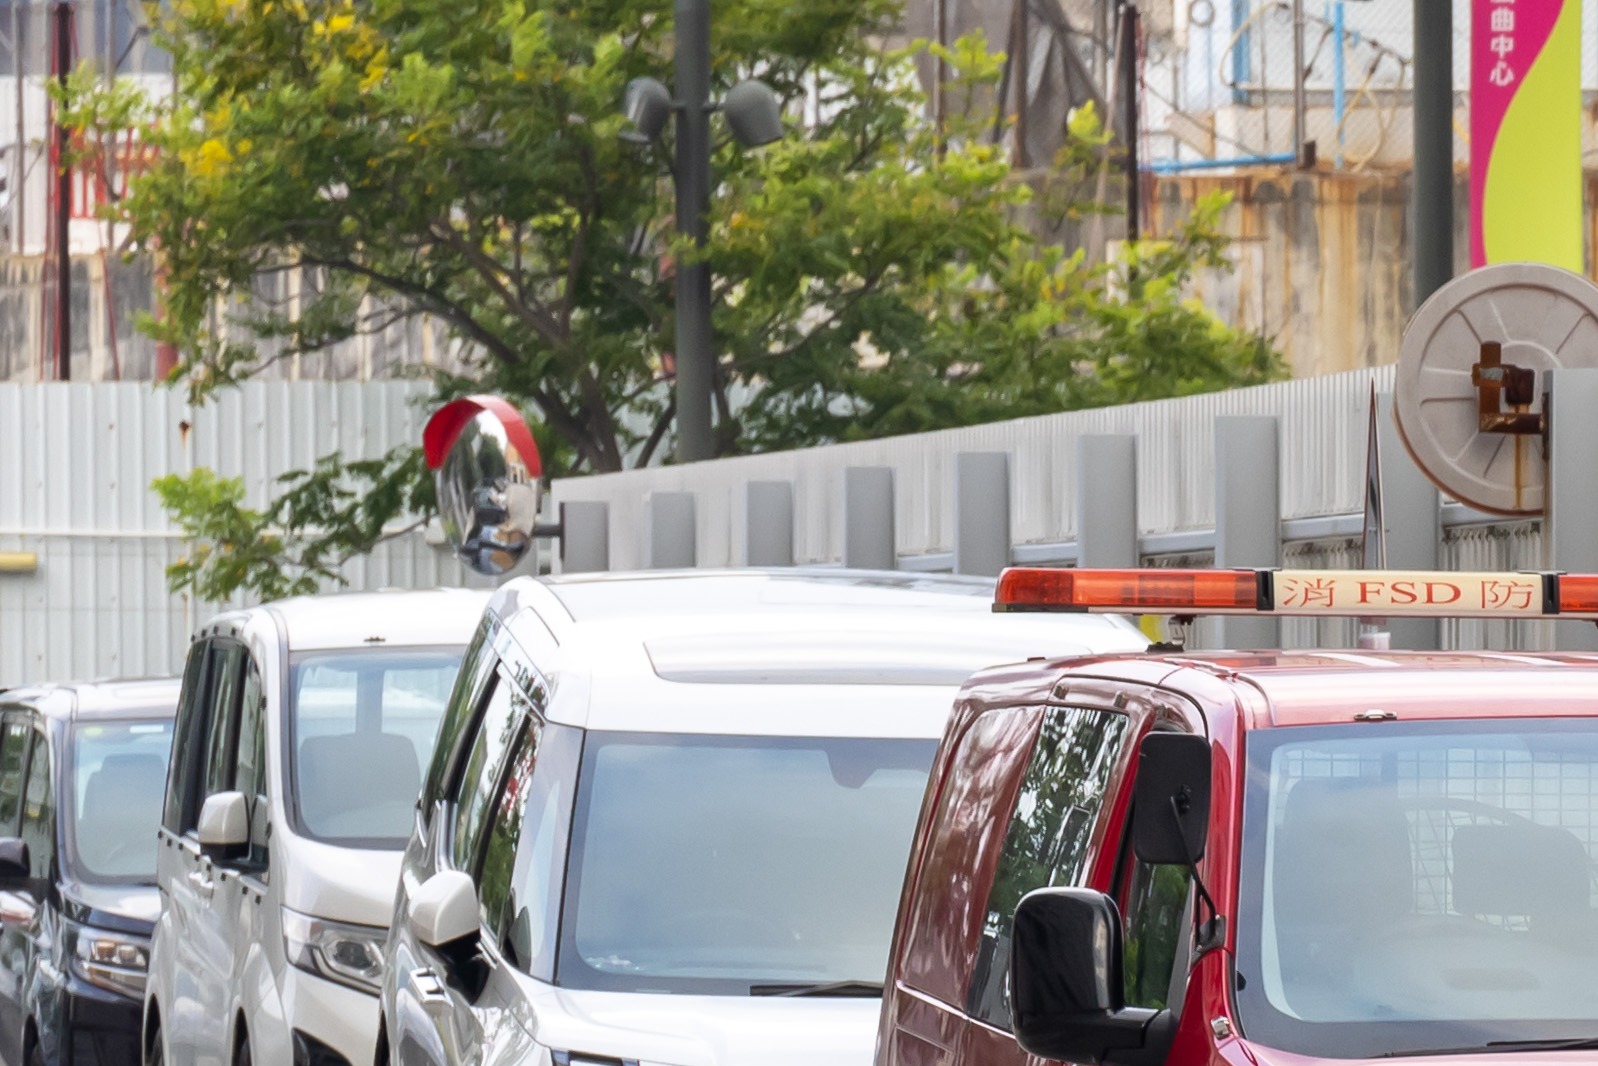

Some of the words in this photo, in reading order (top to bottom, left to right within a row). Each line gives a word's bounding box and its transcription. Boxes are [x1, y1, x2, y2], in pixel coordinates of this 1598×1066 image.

[1489, 0, 1516, 87] 曲中心
[1281, 578, 1335, 609] 消
[1355, 581, 1462, 605] FSD
[1479, 578, 1535, 611] 防
